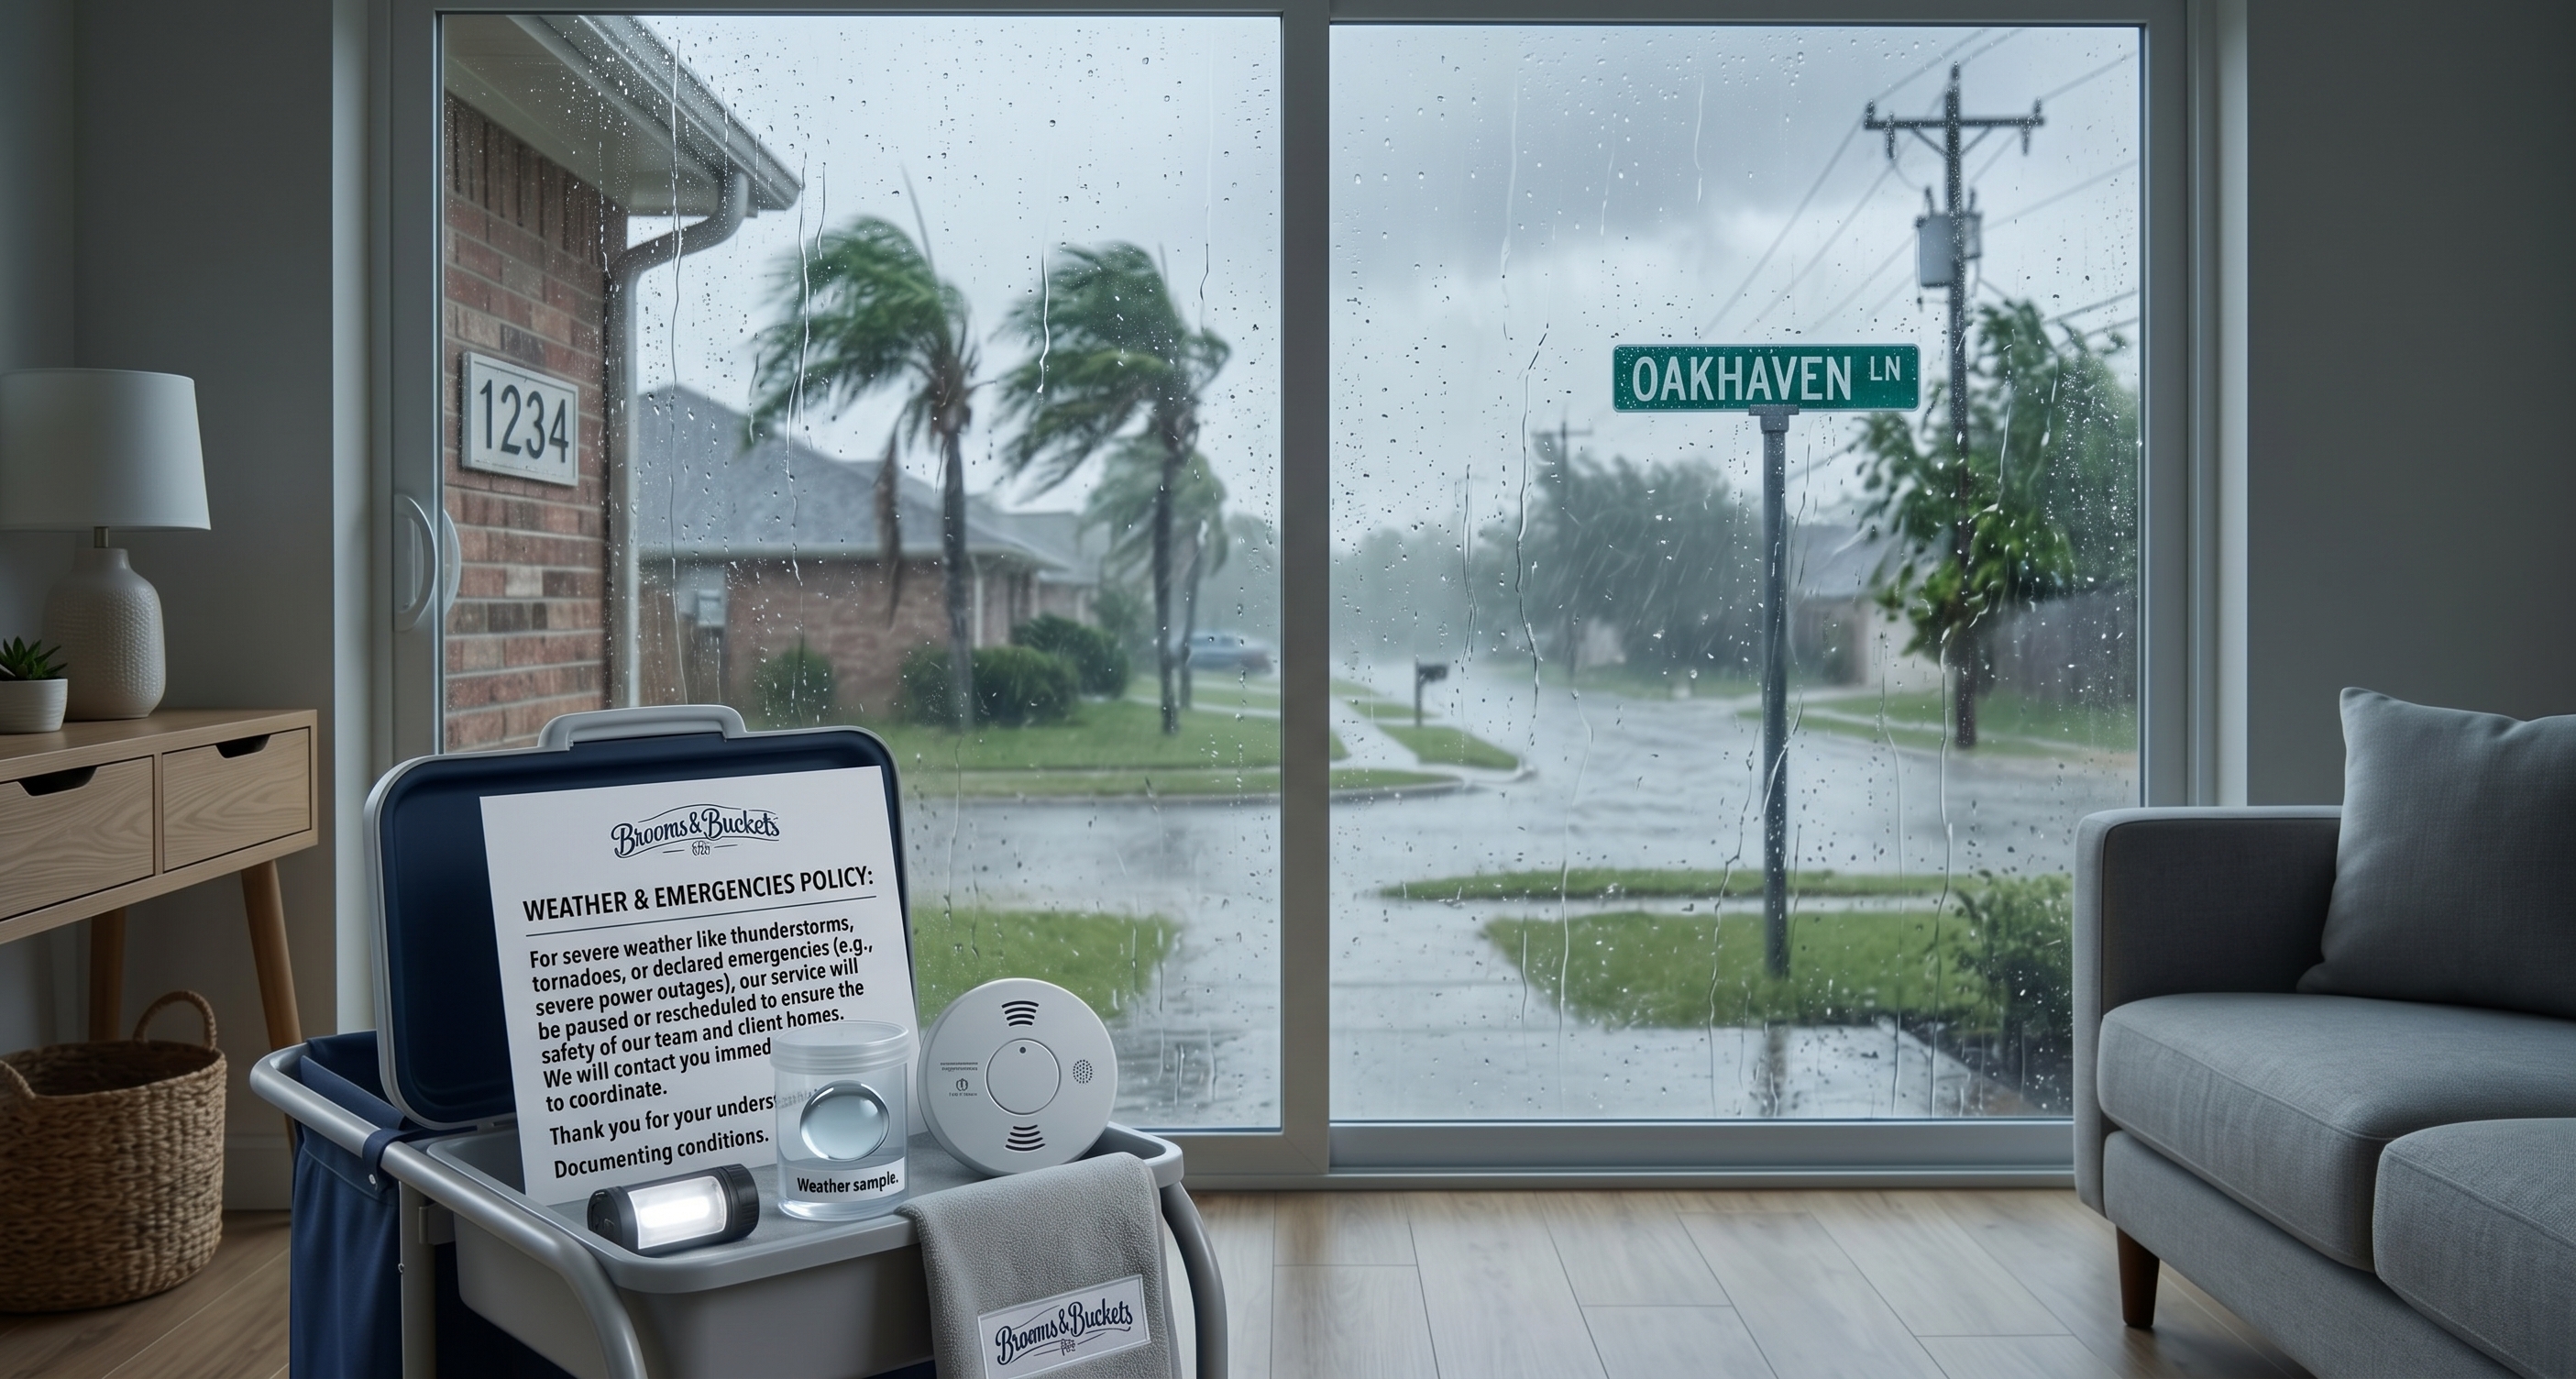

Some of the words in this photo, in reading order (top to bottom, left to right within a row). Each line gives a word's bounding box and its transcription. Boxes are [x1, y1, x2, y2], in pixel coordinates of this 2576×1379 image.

[1632, 355, 1852, 402] OAKHAVEN
[1869, 355, 1901, 381] LN
[479, 379, 569, 464] 1234
[523, 891, 629, 921] WEATHER
[633, 888, 650, 910] &
[655, 873, 796, 909] EMERGENCIES
[799, 866, 874, 892] POLICY:
[530, 950, 558, 969] For
[562, 945, 620, 965] severe
[622, 934, 693, 957] weather
[696, 929, 727, 948] like
[730, 918, 854, 944] thunderstorms,
[532, 967, 626, 993] tornadoes,
[631, 965, 649, 980] or
[653, 951, 724, 977] declared
[728, 941, 830, 968] emergencies
[833, 936, 873, 958] (e.g.,
[535, 996, 594, 1017] severe
[599, 987, 654, 1014] power
[657, 972, 736, 1000] outages),
[739, 973, 767, 989] our
[771, 964, 826, 986] service
[829, 956, 859, 977] will
[537, 1021, 561, 1041] be
[565, 1010, 629, 1042] paused
[633, 1012, 652, 1028] or
[655, 993, 757, 1024] rescheduled
[760, 994, 777, 1009] to
[781, 987, 835, 1007] ensure
[838, 980, 864, 998] the
[541, 1042, 595, 1065] safety
[600, 1034, 618, 1056] of
[622, 1035, 651, 1053] our
[654, 1030, 698, 1048] team
[702, 1019, 733, 1042] and
[738, 1014, 784, 1036] client
[786, 1009, 844, 1029] homes.
[543, 1068, 573, 1088] We
[576, 1061, 610, 1084] will
[613, 1054, 677, 1078] contact
[678, 1051, 710, 1074] you
[545, 1096, 565, 1112] to
[569, 1081, 667, 1109] coordinate.
[549, 1120, 605, 1146] Thank
[608, 1118, 641, 1142] you
[644, 1109, 670, 1130] for
[673, 1106, 712, 1131] your
[554, 1144, 673, 1179] Documenting
[677, 1130, 769, 1157] conditions.
[797, 1176, 851, 1194] Weather
[853, 1171, 900, 1192] sample.
